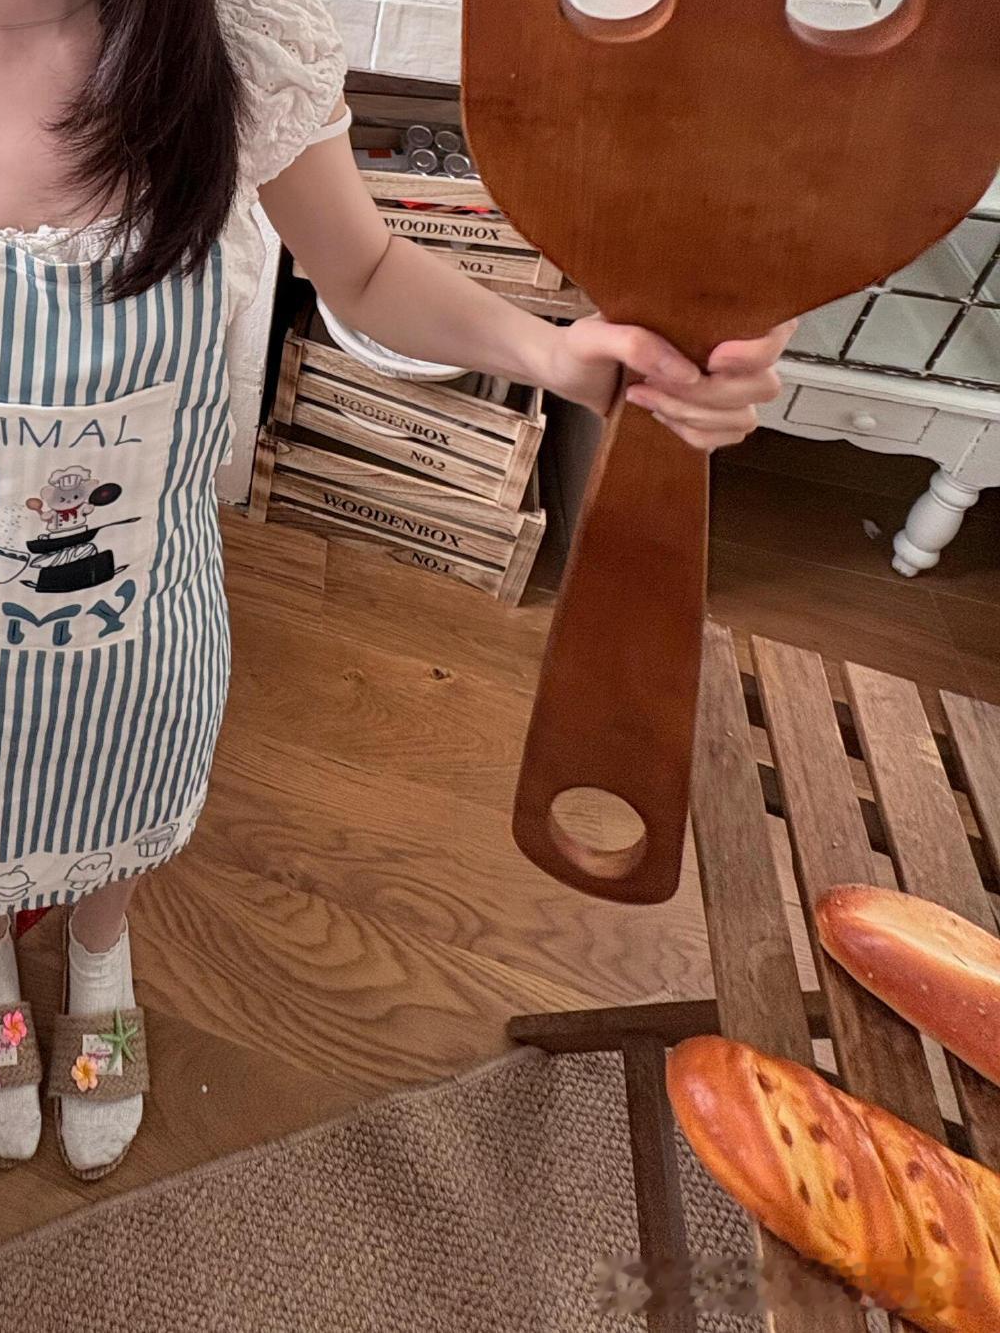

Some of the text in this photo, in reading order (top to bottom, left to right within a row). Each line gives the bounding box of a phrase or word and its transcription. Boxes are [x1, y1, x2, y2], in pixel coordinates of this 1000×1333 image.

[383, 217, 501, 241] WOODENBOX
[459, 260, 493, 275] NO.3
[332, 393, 451, 446] WOODENBOX
[410, 450, 446, 472] NO.2
[323, 492, 463, 548] WOODENBOX
[412, 552, 451, 574] NO.1
